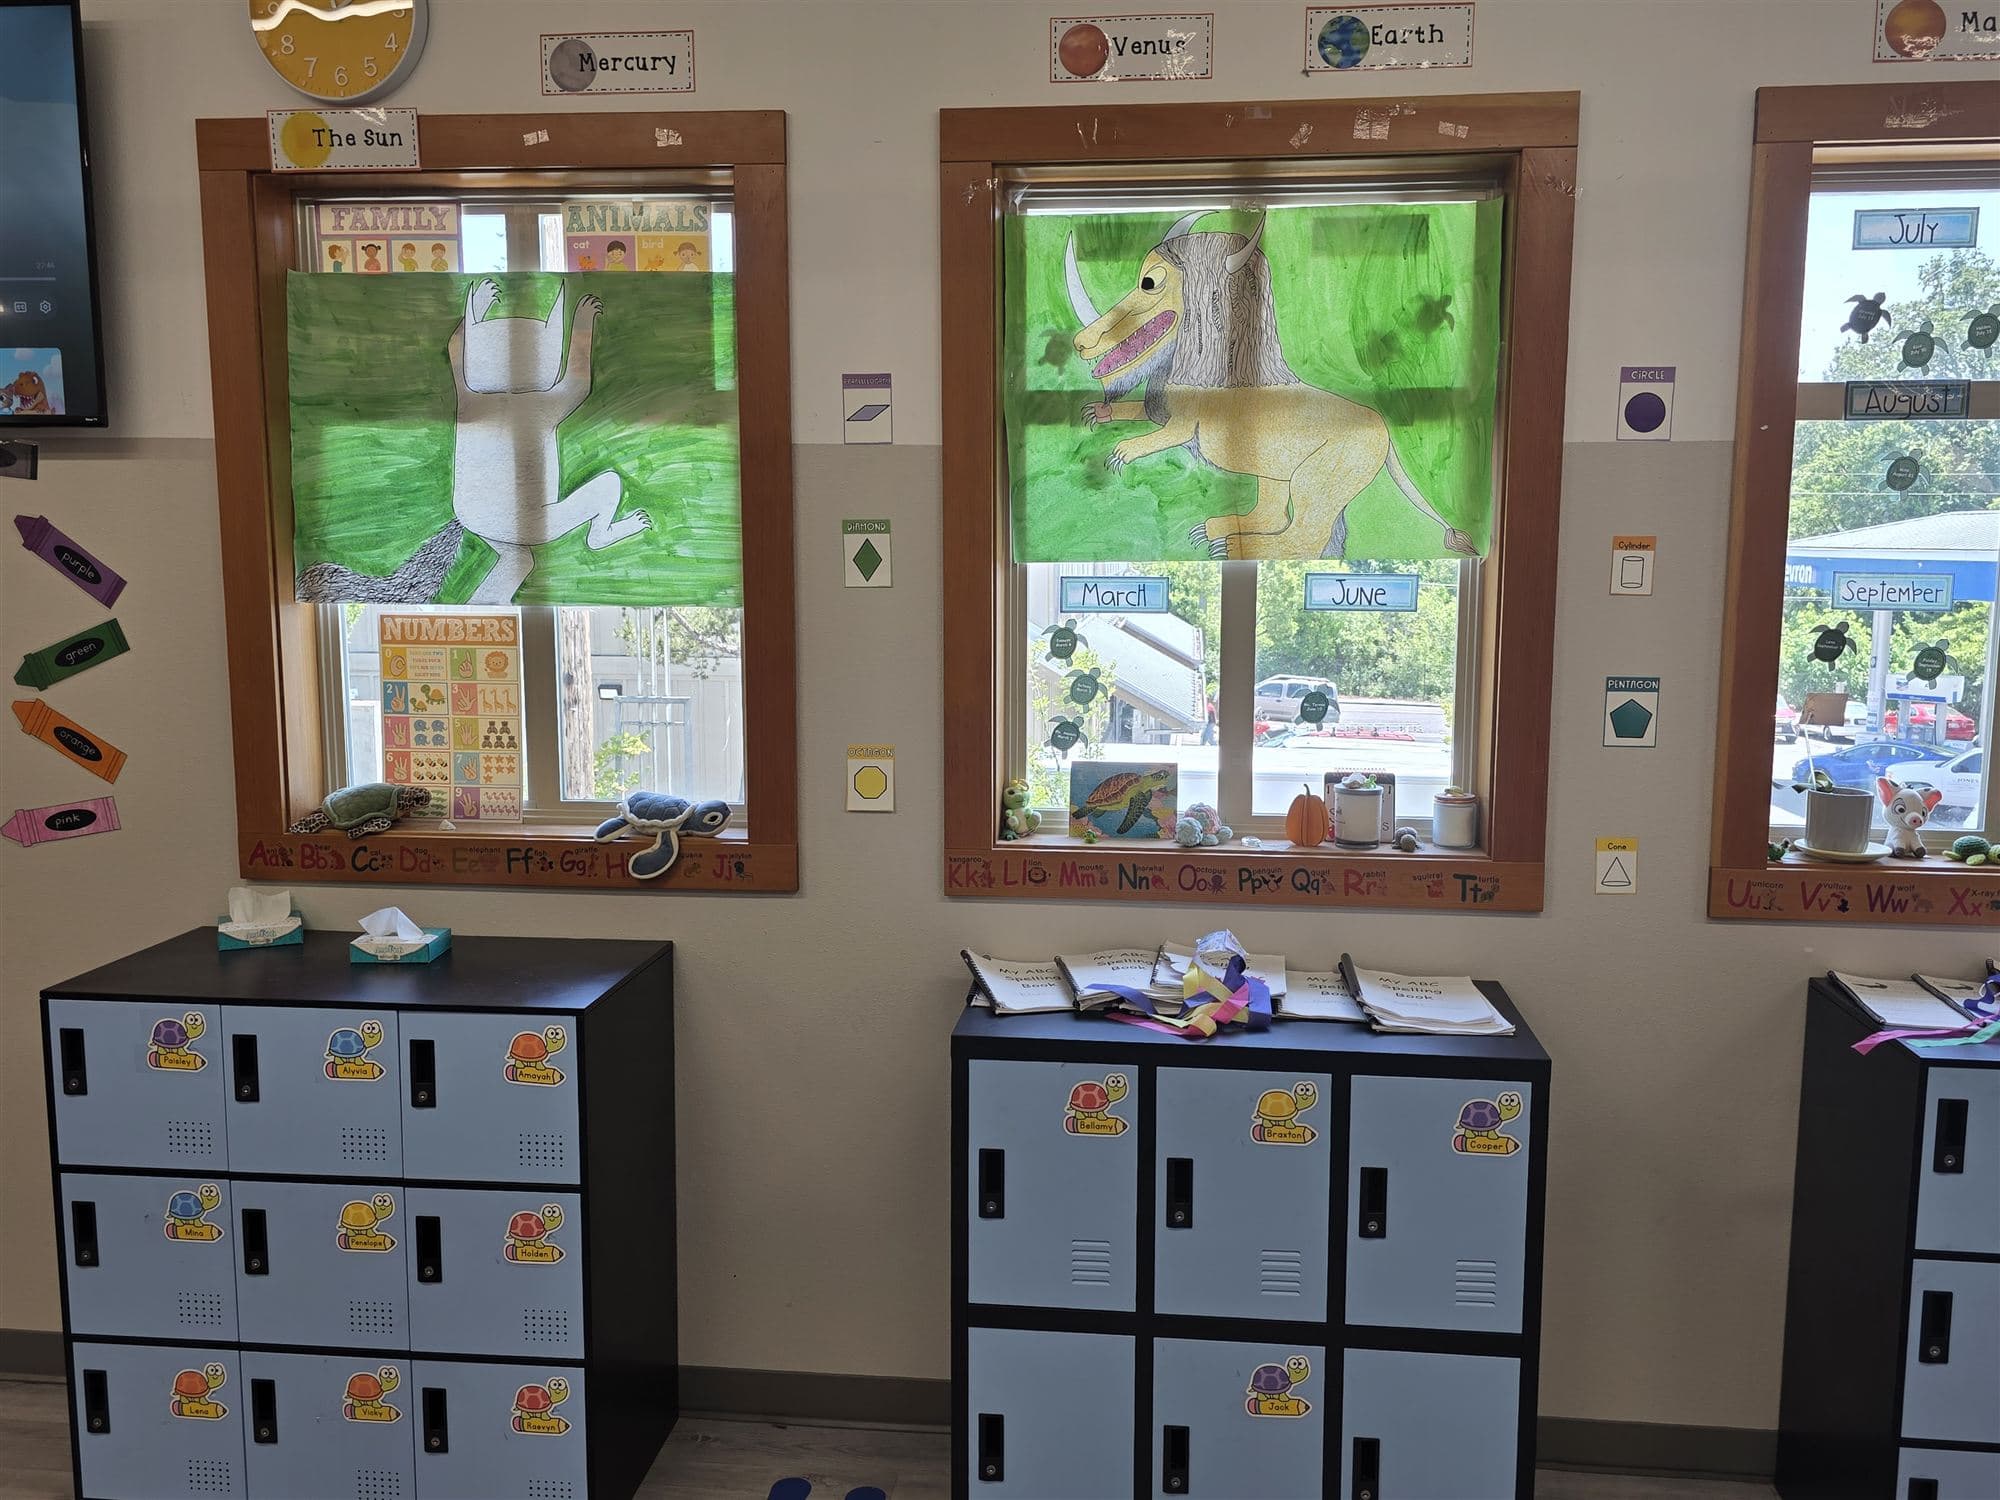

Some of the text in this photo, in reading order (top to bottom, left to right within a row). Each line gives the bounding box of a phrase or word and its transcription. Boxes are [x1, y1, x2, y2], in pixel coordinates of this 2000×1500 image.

[281, 34, 295, 55] 8
[384, 32, 398, 53] 4
[1370, 24, 1445, 46] Earth
[1112, 36, 1186, 56] Venus
[303, 57, 318, 78] 7
[364, 56, 378, 77] 5
[578, 52, 676, 75] Mercury
[334, 66, 349, 86] 6
[312, 128, 403, 147] The Sun
[331, 206, 451, 232] FAMILY
[566, 204, 709, 233] ANIMALS
[1888, 213, 1939, 244] July
[573, 240, 591, 250] cat
[642, 238, 664, 250] bird
[1865, 385, 1951, 419] August
[1618, 541, 1651, 551] Cylinder
[61, 552, 96, 580] purple
[1841, 580, 1944, 607] September
[384, 617, 516, 642] NUMBERS
[65, 641, 97, 664] green
[386, 683, 393, 694] 2
[452, 683, 459, 694] 3
[1608, 679, 1659, 690] PENTAGON
[60, 729, 97, 756] orange
[386, 753, 394, 762] 6
[456, 754, 462, 763] 7
[455, 788, 462, 796] 9
[55, 814, 81, 828] pink
[248, 840, 279, 867] Aa
[300, 843, 327, 869] Bb
[1607, 842, 1627, 851] Cone
[352, 846, 380, 873] Cc
[400, 846, 431, 873] Dd
[452, 847, 481, 873] Ee
[506, 847, 534, 874] Ff
[560, 851, 587, 876] Gg
[605, 852, 631, 878] H
[712, 854, 733, 880] Jj
[949, 855, 982, 864] kangaroo
[1078, 863, 1104, 871] mouse
[949, 863, 979, 888] Kk
[1059, 861, 1097, 887] Mm
[1118, 863, 1150, 890] Nn
[1178, 864, 1207, 891] Oo
[1195, 866, 1226, 875] octopus
[1238, 867, 1262, 895] Pp
[1362, 870, 1386, 878] rabbit
[1291, 868, 1320, 896] Qq
[1343, 869, 1377, 896] Rr
[1453, 873, 1482, 903] Tt
[1751, 881, 1784, 889] unicorn
[1727, 878, 1761, 910] Uu
[1800, 881, 1832, 913] Vv
[1866, 883, 1908, 914] Ww
[1947, 887, 1982, 916] Xx
[999, 967, 1054, 976] My ABC
[1096, 959, 1154, 968] Spelling
[1004, 975, 1062, 985] Spelling
[1379, 977, 1401, 985] My
[163, 1055, 192, 1067] Paisley
[342, 1065, 368, 1077] Alyvia
[518, 1070, 551, 1082] Amayah
[1079, 1120, 1114, 1132] Bellamy
[1266, 1129, 1302, 1140] Braxton
[1470, 1140, 1504, 1151] Cooper
[185, 1228, 204, 1237] Mina
[351, 1238, 383, 1249] Penelope
[520, 1248, 549, 1259] Holden
[189, 1406, 209, 1416] Lena
[361, 1407, 383, 1419] Vicky
[1268, 1402, 1290, 1411] Jack
